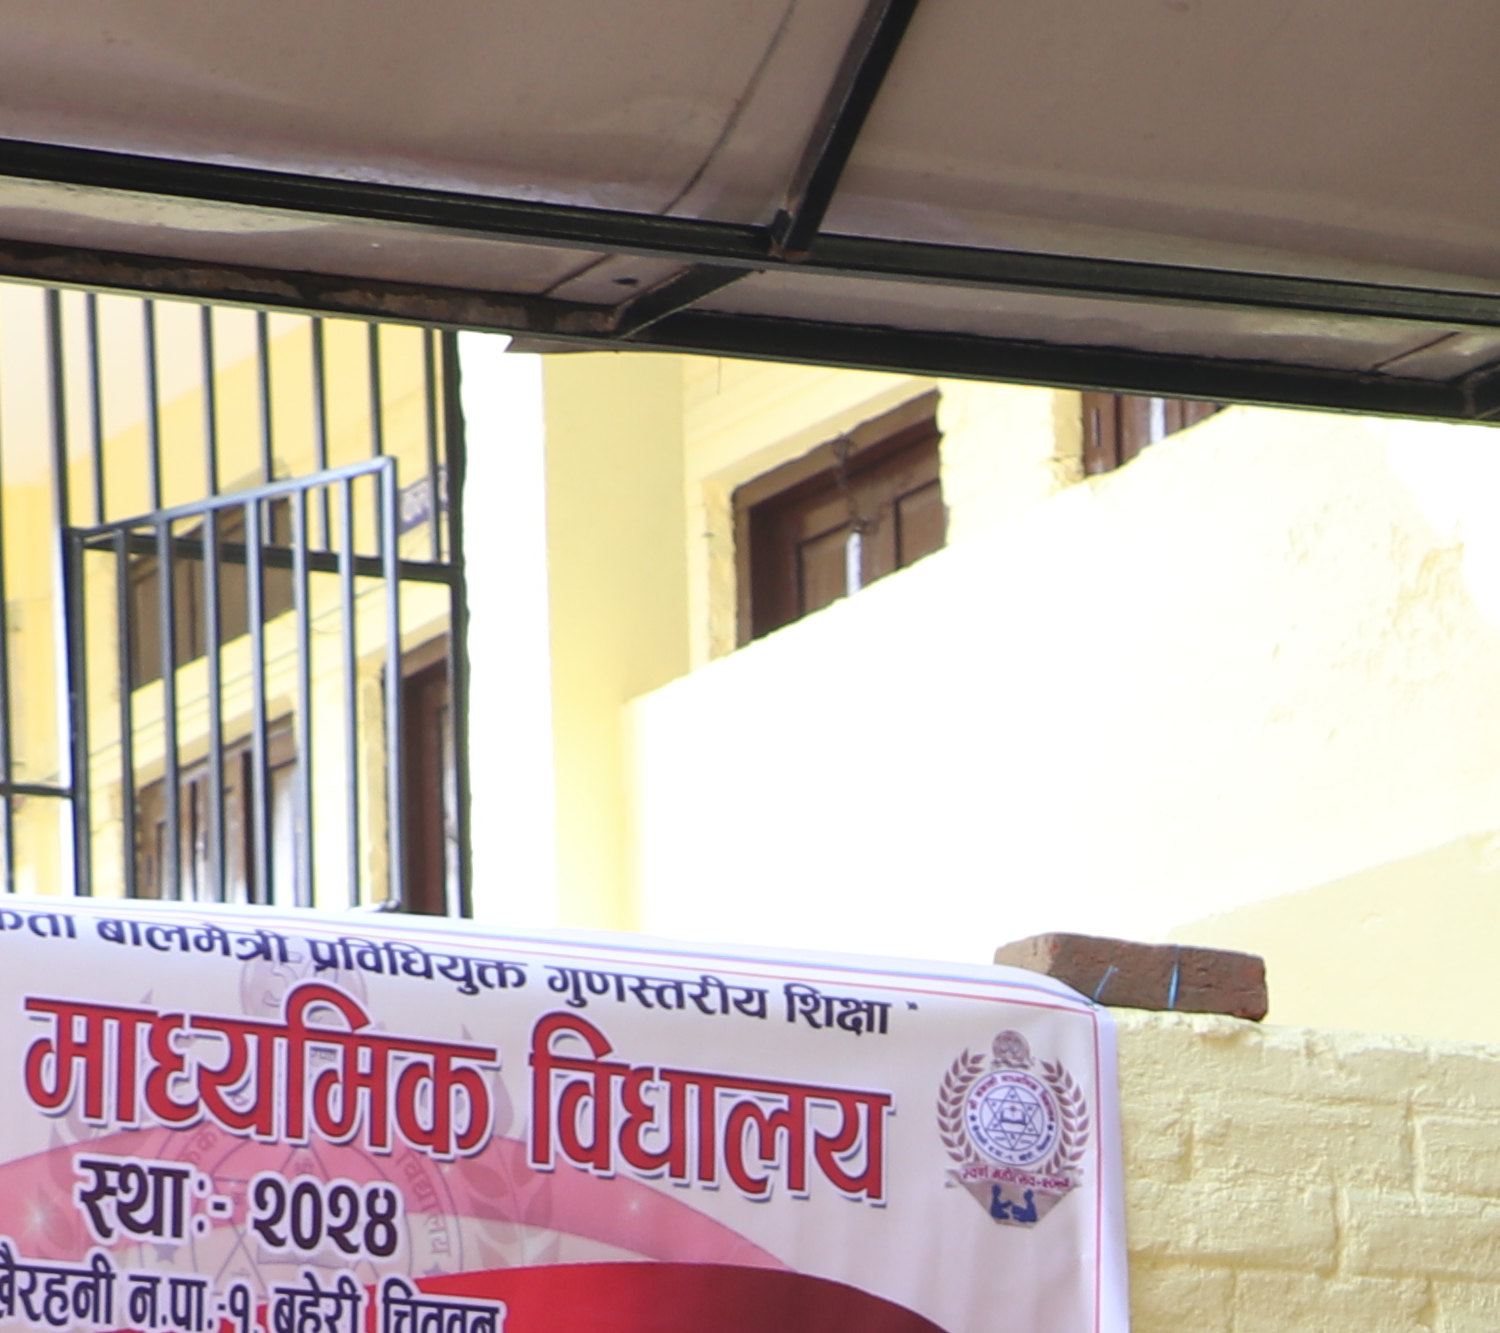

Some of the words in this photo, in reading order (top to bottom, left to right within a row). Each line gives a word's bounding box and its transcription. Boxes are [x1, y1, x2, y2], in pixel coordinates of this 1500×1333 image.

[543, 964, 768, 1020] गुणस्तरीय
[783, 982, 894, 1035] शिक्षा
[24, 982, 498, 1155] माध्यमिक
[253, 1177, 397, 1257] २०२४
